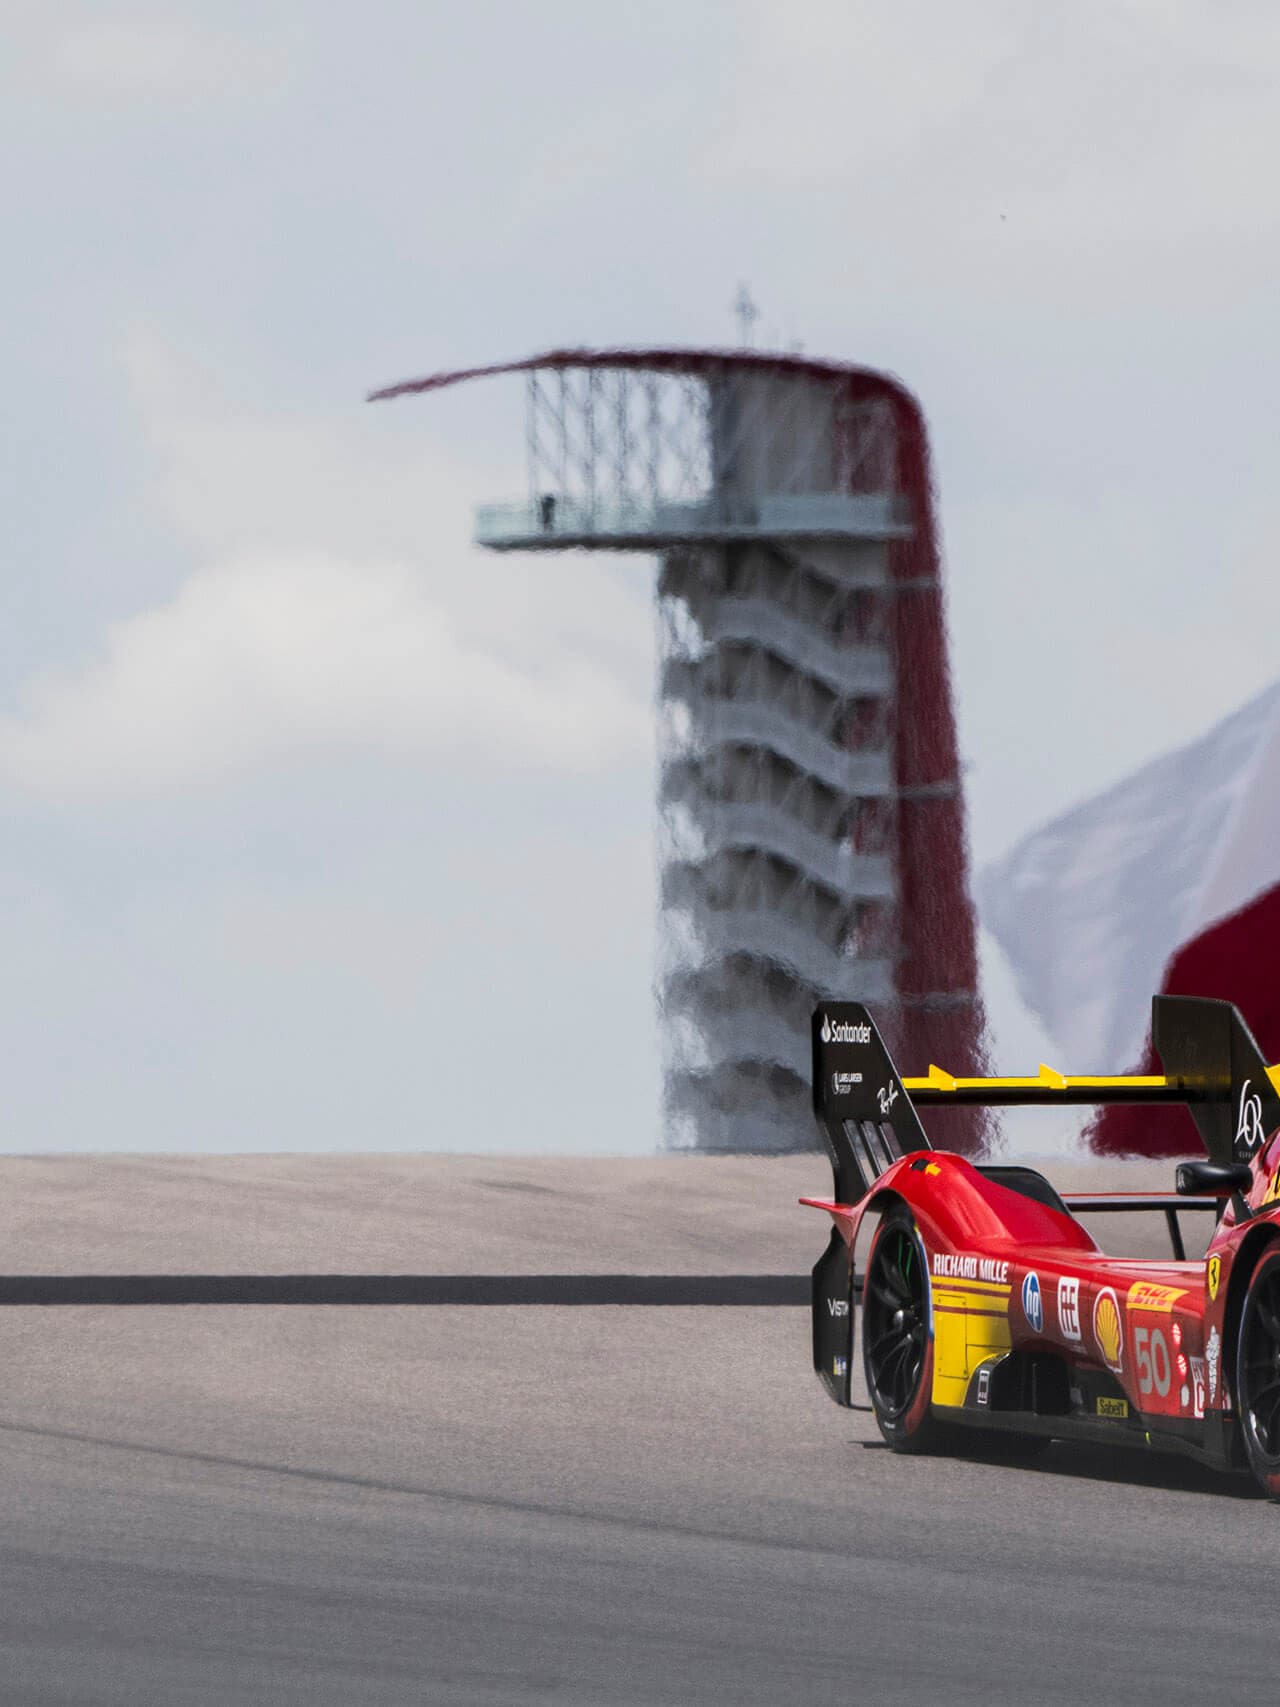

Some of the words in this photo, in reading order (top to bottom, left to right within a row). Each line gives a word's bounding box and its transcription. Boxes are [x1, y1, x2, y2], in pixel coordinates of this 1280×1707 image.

[831, 1020, 872, 1044] Santander
[933, 1253, 978, 1279] RICHARD
[979, 1258, 1010, 1283] MILLE
[1134, 1326, 1171, 1398] 50
